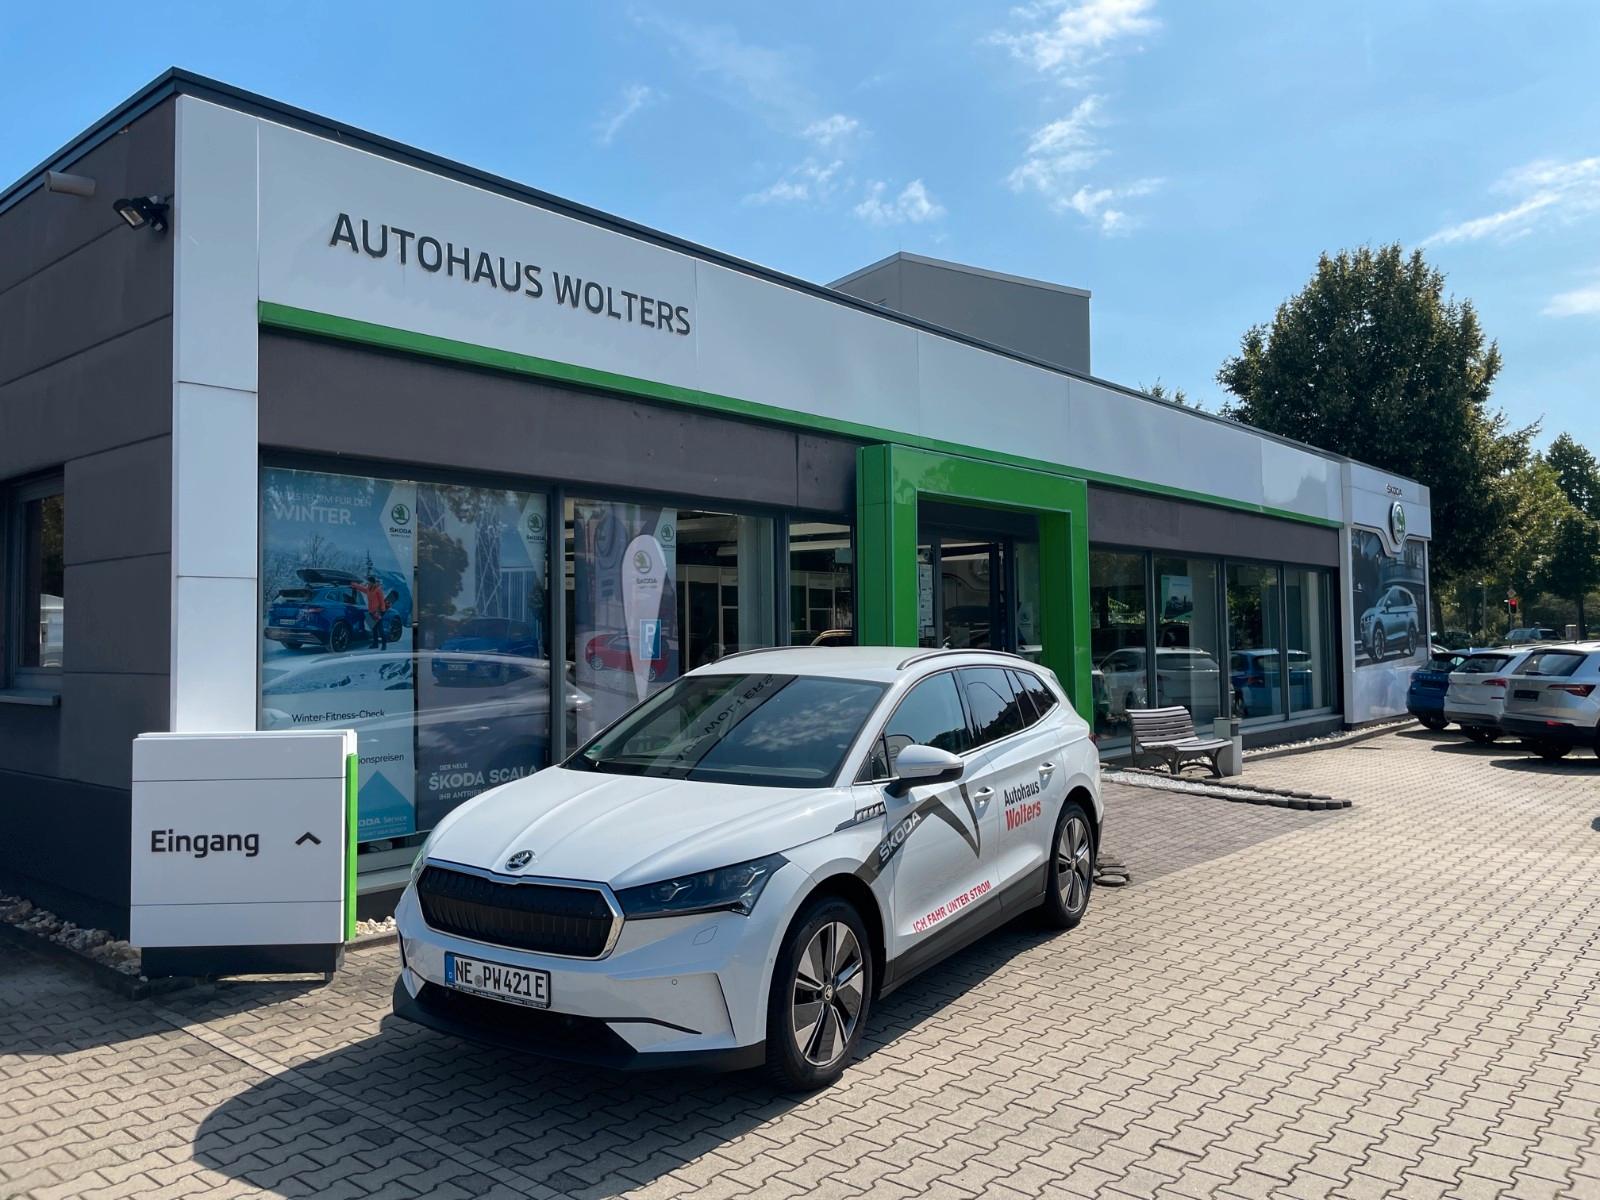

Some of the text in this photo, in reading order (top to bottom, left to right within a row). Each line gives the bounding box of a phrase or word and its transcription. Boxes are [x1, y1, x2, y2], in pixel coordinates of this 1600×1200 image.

[330, 212, 692, 335] AUTOHAUS WOLTERS
[645, 623, 657, 642] P
[291, 709, 385, 723] Winter-Fitness-Check
[358, 753, 405, 765] ionspreisen
[429, 772, 485, 791] ŠKODA
[1004, 781, 1040, 807] Autohaus
[1005, 801, 1041, 831] Wolters
[151, 829, 260, 858] Eingang
[879, 811, 921, 862] ŠKODA
[912, 880, 992, 933] ICH FAHR UNTER STROM
[455, 960, 473, 985] NE
